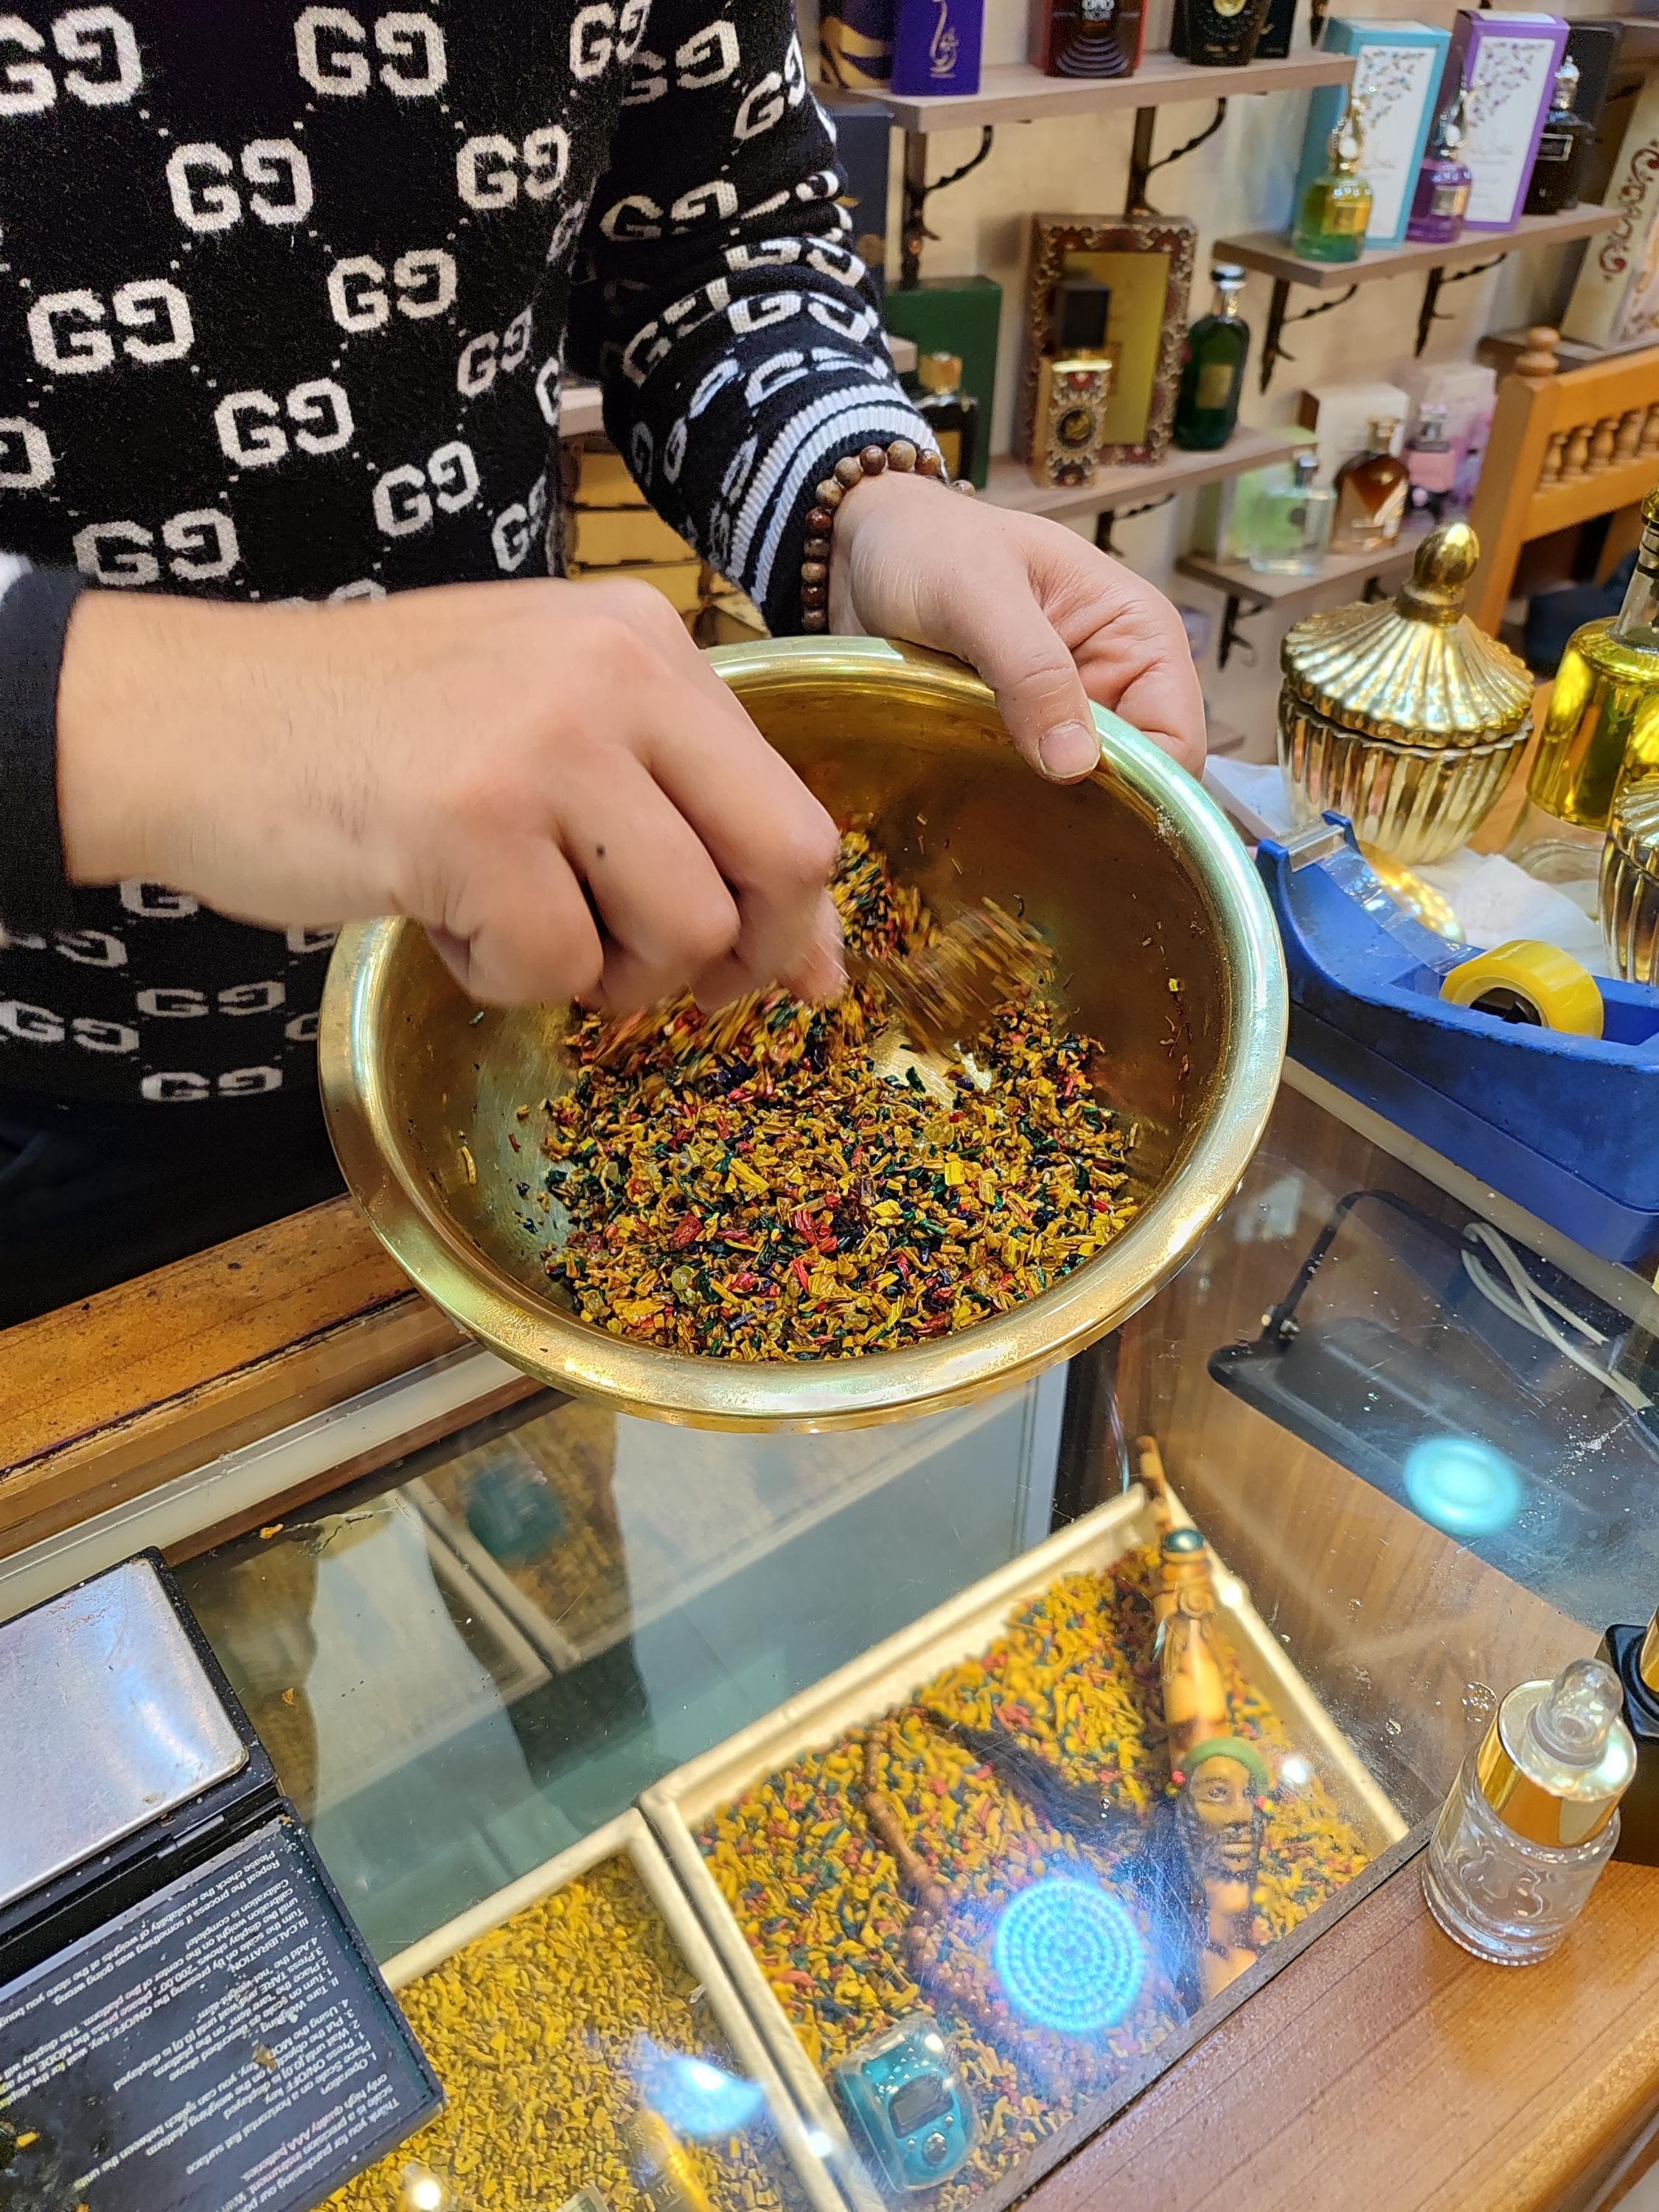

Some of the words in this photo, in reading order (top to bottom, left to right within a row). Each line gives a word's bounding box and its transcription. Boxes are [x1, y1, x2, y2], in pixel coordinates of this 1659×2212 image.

[243, 1849, 276, 1873] Please
[215, 1870, 243, 1891] check
[246, 1859, 280, 1885] Repeat
[199, 1887, 216, 1901] the
[230, 1880, 247, 1893] the
[240, 1879, 289, 1913] Calibration
[192, 1888, 230, 1917] process
[246, 1888, 293, 1921] calibration
[278, 1897, 299, 1915] until
[151, 1897, 199, 1933] availability
[185, 1914, 194, 1925] if
[230, 1909, 240, 1919] is
[262, 1910, 279, 1924] the
[281, 1907, 304, 1924] Turn
[135, 1915, 185, 1955] something
[139, 1928, 150, 1941] of
[184, 1916, 230, 1950] complete!
[215, 1918, 247, 1943] weight
[229, 1921, 262, 1947] display
[265, 1921, 282, 1935] the
[101, 1935, 139, 1963] weights
[201, 1938, 215, 1950] on
[239, 1932, 265, 1952] scale
[289, 1936, 318, 1960] 4.Add
[114, 1950, 136, 1967] was
[185, 1947, 202, 1961] the
[196, 1942, 229, 1966] shows
[212, 1958, 226, 1970] by
[225, 1949, 239, 1963] on
[273, 1955, 291, 1969] the
[287, 1946, 324, 1973] 3.Press
[72, 1966, 90, 1981] the
[86, 1962, 114, 1986] going
[89, 1959, 101, 1972] at
[154, 1958, 184, 1982] center
[293, 1955, 329, 1983] 2.Place
[46, 1977, 72, 1997] store
[142, 1978, 153, 1991] of
[170, 1964, 212, 1997] pressing
[259, 1971, 288, 1994] TARE
[275, 1980, 293, 1995] the
[302, 1967, 333, 1991] 1.Turn
[328, 1976, 339, 1987] II.
[25, 1992, 46, 2011] you
[125, 1983, 142, 2000] the
[153, 1993, 170, 2008] the
[237, 1988, 258, 2008] and
[288, 1987, 302, 2000] on
[306, 1985, 329, 2002] Tare
[119, 1989, 153, 2017] please
[218, 2003, 239, 2022] wait
[262, 1995, 289, 2018] scale
[338, 1998, 349, 2008] 4.
[90, 2011, 119, 2036] press
[108, 2006, 153, 2039] ON/OFF
[248, 2014, 262, 2028] as
[309, 2006, 338, 2029] Using
[343, 2008, 355, 2019] 3.
[59, 2025, 80, 2042] The
[195, 2016, 218, 2037] until
[212, 2025, 226, 2038] on
[293, 2025, 310, 2040] the
[324, 2015, 344, 2034] Put
[349, 2019, 361, 2030] 2.
[72, 2031, 91, 2047] the
[171, 2028, 196, 2053] [0.0]
[195, 2034, 212, 2050] the
[200, 2023, 249, 2062] described
[308, 2028, 326, 2043] the
[325, 2027, 349, 2048] Wait
[354, 2031, 365, 2040] 1.
[22, 2038, 58, 2067] display
[36, 2043, 73, 2072] MODE
[66, 2047, 88, 2067] wait
[161, 2046, 173, 2057] is
[304, 2042, 326, 2063] until
[325, 2037, 355, 2062] Press
[343, 2040, 372, 2064] Place
[3, 2062, 22, 2079] will
[50, 2062, 66, 2076] for
[153, 2043, 195, 2078] platform
[168, 2056, 200, 2081] above
[280, 2054, 305, 2079] [0.0]
[16, 2066, 37, 2084] key
[32, 2070, 50, 2087] the
[113, 2053, 161, 2092] displayed
[251, 2070, 266, 2084] on
[271, 2073, 282, 2084] is
[285, 2058, 326, 2093] ON/OFF
[314, 2060, 344, 2084] Scale
[320, 2058, 369, 2096] Operation
[217, 2072, 237, 2093] you
[234, 2079, 252, 2096] the
[299, 2080, 314, 2095] on
[366, 2073, 388, 2093] only
[197, 2088, 218, 2106] can
[223, 2081, 271, 2121] displayed
[291, 2090, 299, 2101] a
[343, 2088, 367, 2110] high
[366, 2084, 394, 2108] scale
[164, 2101, 198, 2129] switch
[187, 2091, 234, 2127] weighing
[242, 2096, 292, 2138] horizontal
[347, 2111, 356, 2122] a
[355, 2104, 367, 2116] is
[367, 2097, 400, 2124] Thank
[311, 2105, 344, 2134] quality
[347, 2116, 368, 2138] you
[119, 2124, 165, 2160] between
[145, 2121, 189, 2157] platform
[223, 2131, 243, 2149] flat
[286, 2128, 310, 2151] AAA
[302, 2115, 348, 2155] precision
[333, 2133, 349, 2149] for
[101, 2155, 119, 2172] the
[186, 2143, 225, 2175] surface
[276, 2143, 333, 2190] purchasing
[260, 2185, 277, 2203] our
